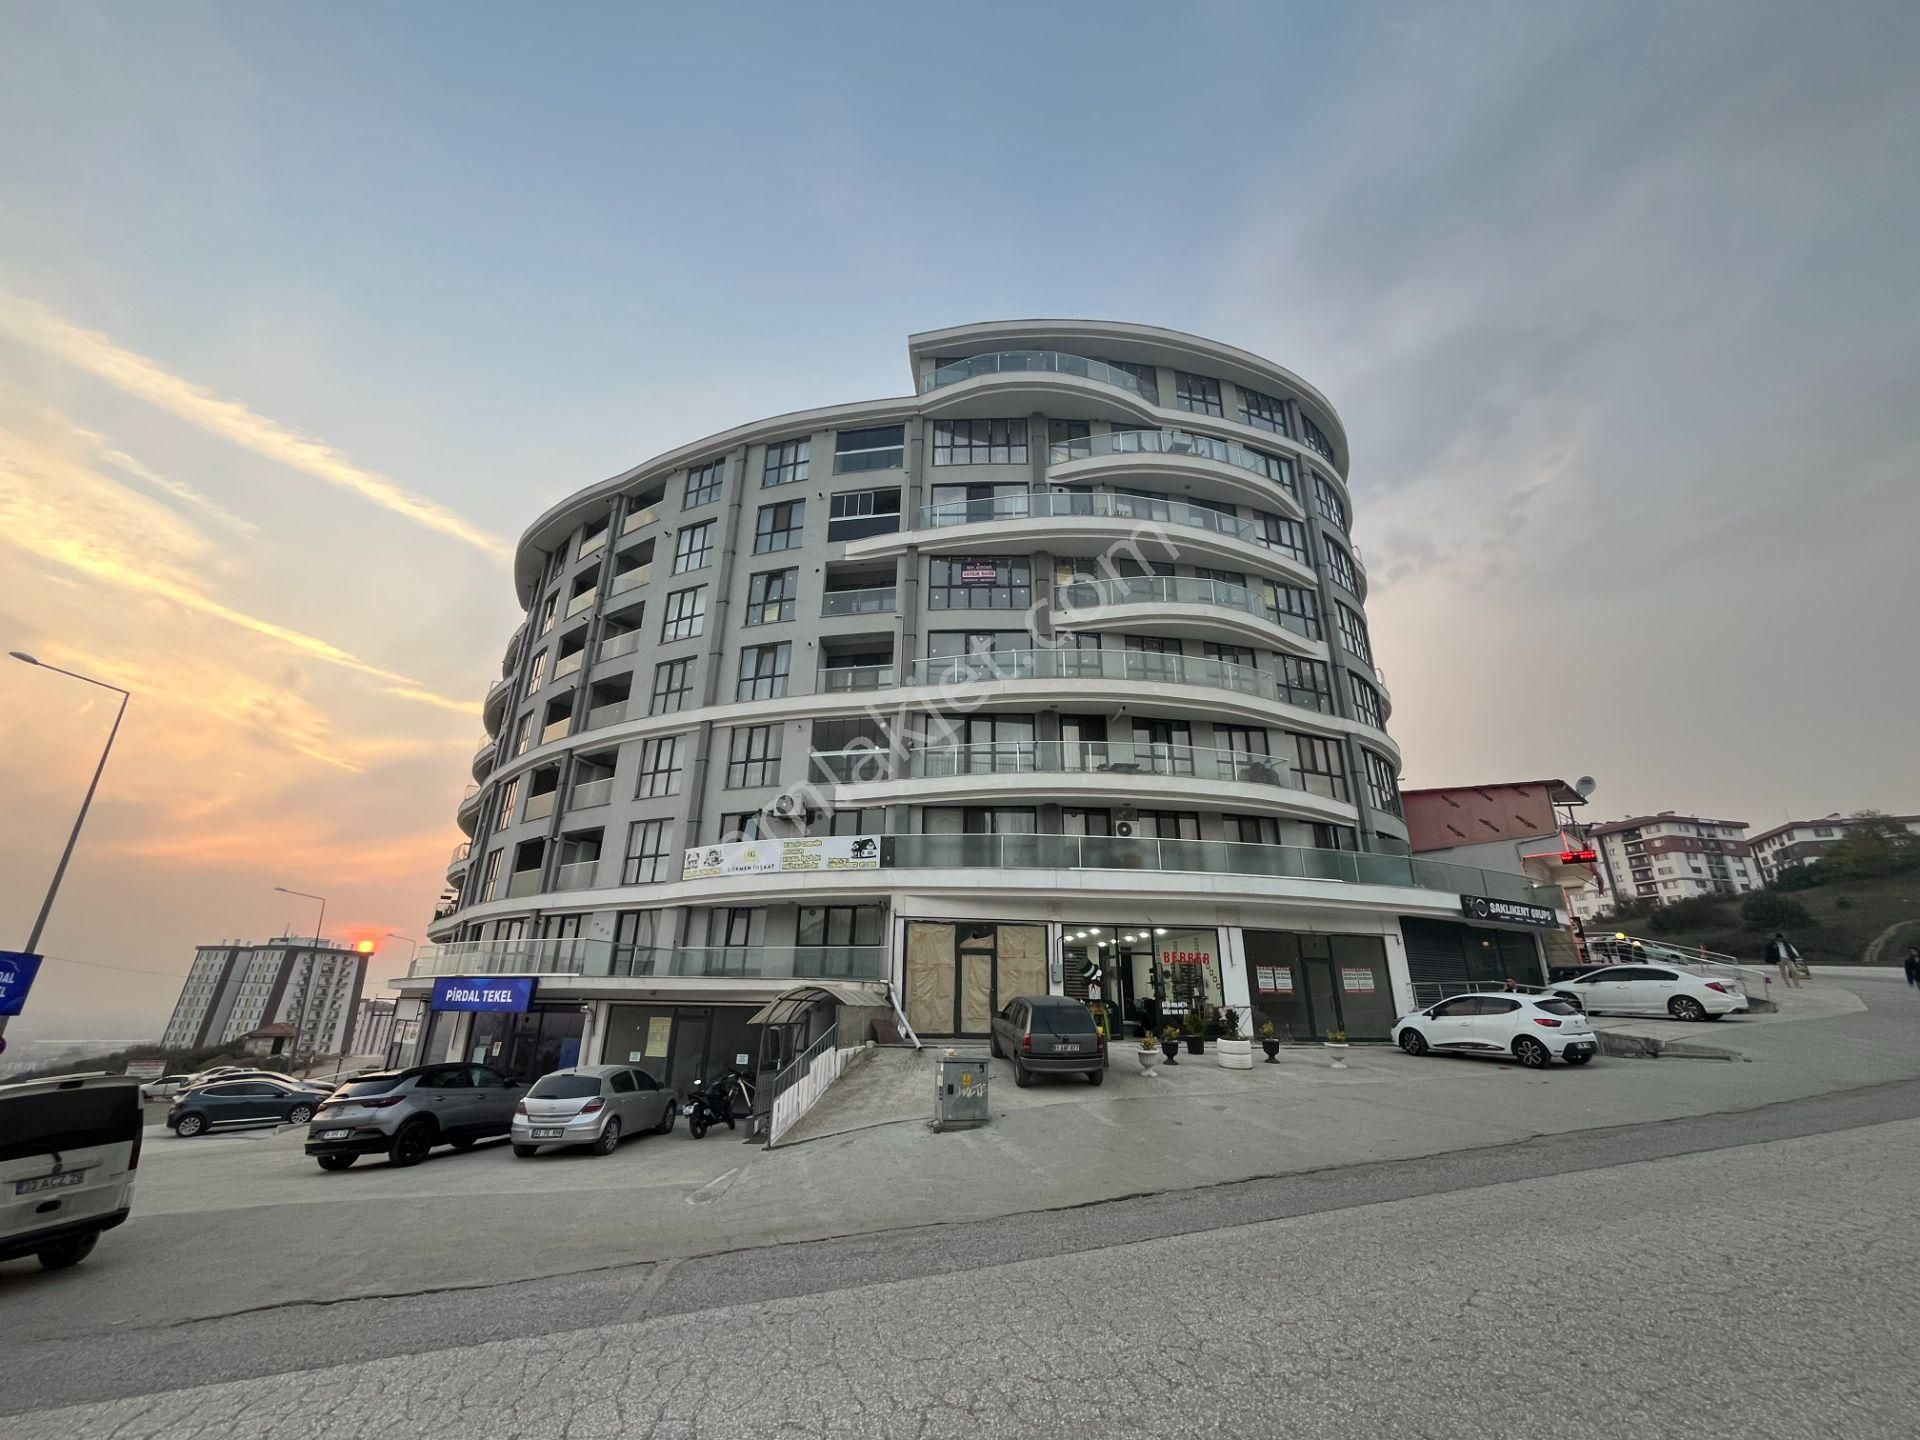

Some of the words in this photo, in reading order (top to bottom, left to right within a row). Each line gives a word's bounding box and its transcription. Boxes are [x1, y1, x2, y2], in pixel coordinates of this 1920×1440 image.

[1489, 902, 1530, 917] SAKLIKENT
[1163, 951, 1210, 965] BERBER
[445, 986, 480, 1002] PİRDAL
[482, 989, 513, 1003] TEKEL
